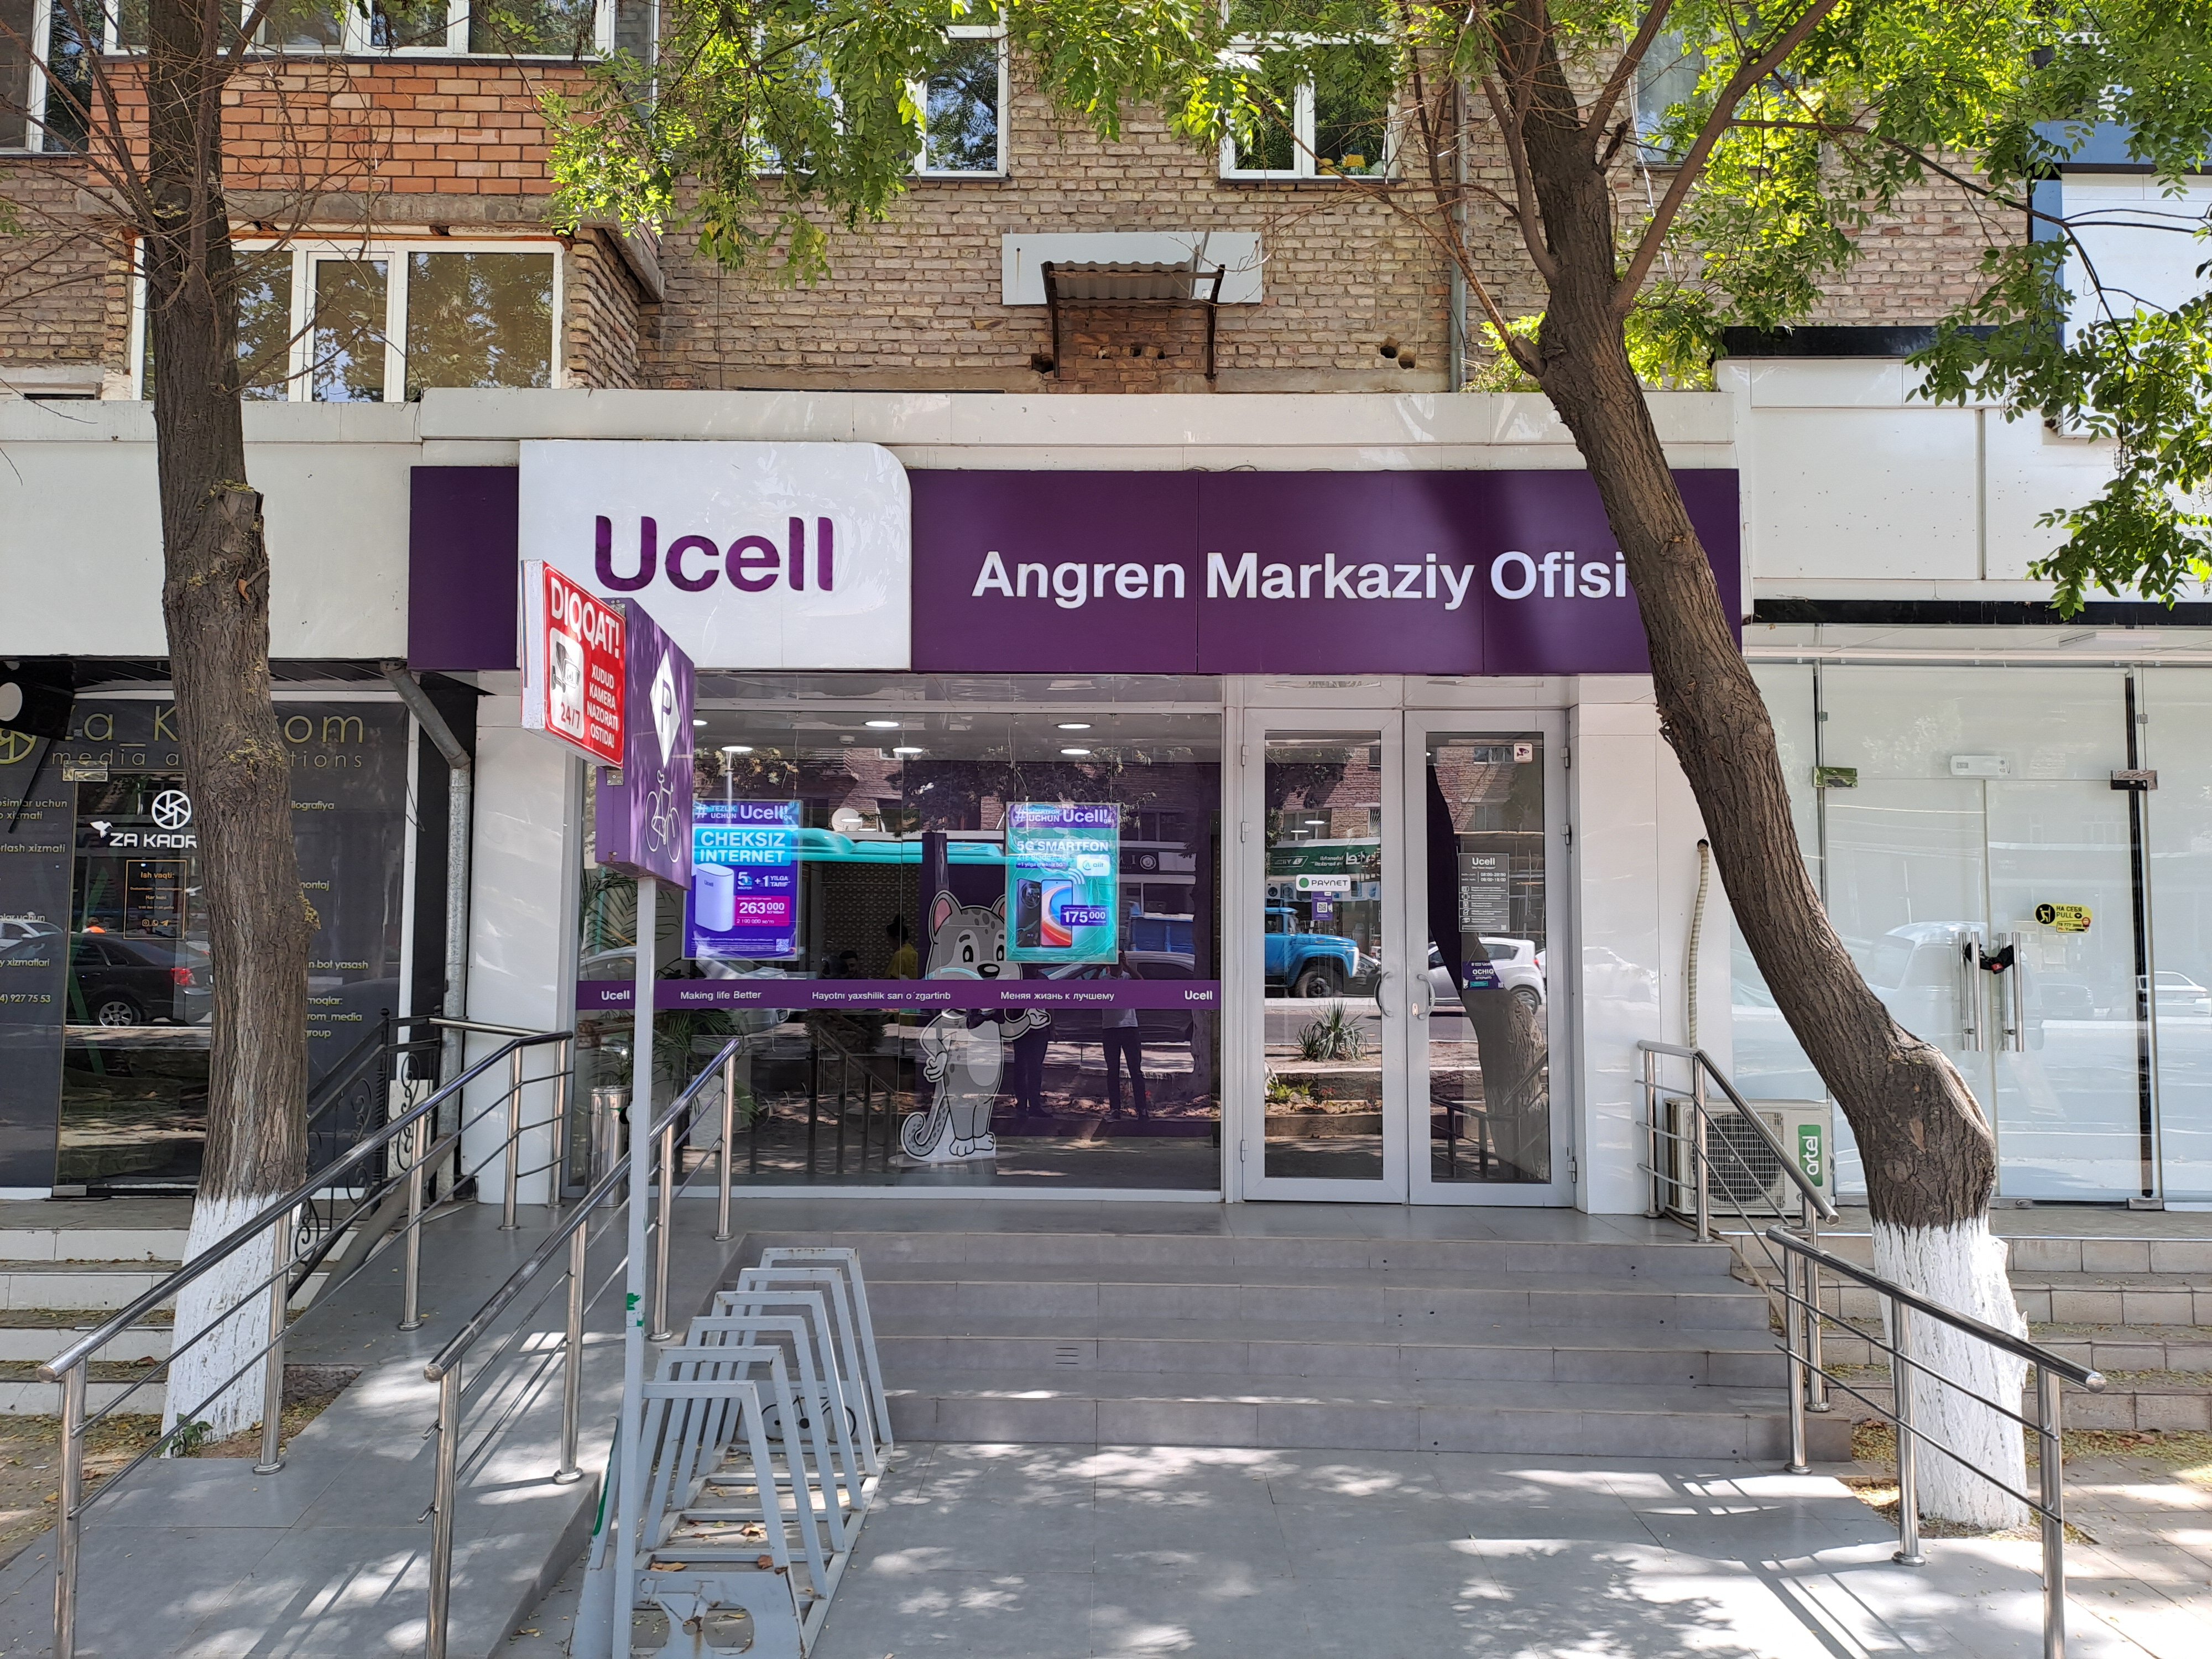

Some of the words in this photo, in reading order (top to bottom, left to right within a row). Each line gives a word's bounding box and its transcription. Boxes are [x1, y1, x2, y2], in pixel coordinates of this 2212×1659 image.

[596, 515, 833, 592] Ucell
[972, 551, 1185, 608] Angren
[1207, 552, 1475, 610] Markaziy
[1491, 551, 1626, 599] Ofisi
[551, 577, 620, 659] DIQQAT!
[592, 664, 614, 690] XUDUD
[589, 684, 616, 710] KAMERA
[661, 678, 672, 733] P
[561, 702, 580, 730] 24/7
[587, 701, 618, 732] NAZORATI
[590, 722, 614, 749] OSTIDA!
[35, 799, 67, 807] uchun
[109, 832, 138, 847] ZA
[701, 831, 786, 847] CHEKSIZ
[28, 844, 66, 853] xizmati
[1017, 841, 1034, 851] 5G
[1037, 841, 1109, 852] SMARTFON
[700, 849, 785, 863] INTERNET
[1472, 857, 1495, 865] Ucell
[739, 902, 766, 914] 263
[766, 902, 785, 911] 000
[1063, 911, 1088, 923] 175
[1089, 911, 1105, 920] 000
[7, 957, 50, 967] xizmatlari
[317, 959, 332, 968] bot
[335, 960, 369, 971] yasash
[10, 994, 25, 1003] 927
[28, 995, 38, 1003] 75
[40, 995, 51, 1003] 53
[601, 990, 630, 1000] Ucell
[680, 991, 713, 1001] Making
[717, 991, 730, 999] life
[733, 990, 762, 999] Better
[848, 991, 885, 1001] yaxshilik
[1000, 992, 1031, 1000] Меняя
[1073, 993, 1114, 1001] лучшему
[1184, 990, 1213, 1000] Ucell
[1802, 1136, 1819, 1176] artel
